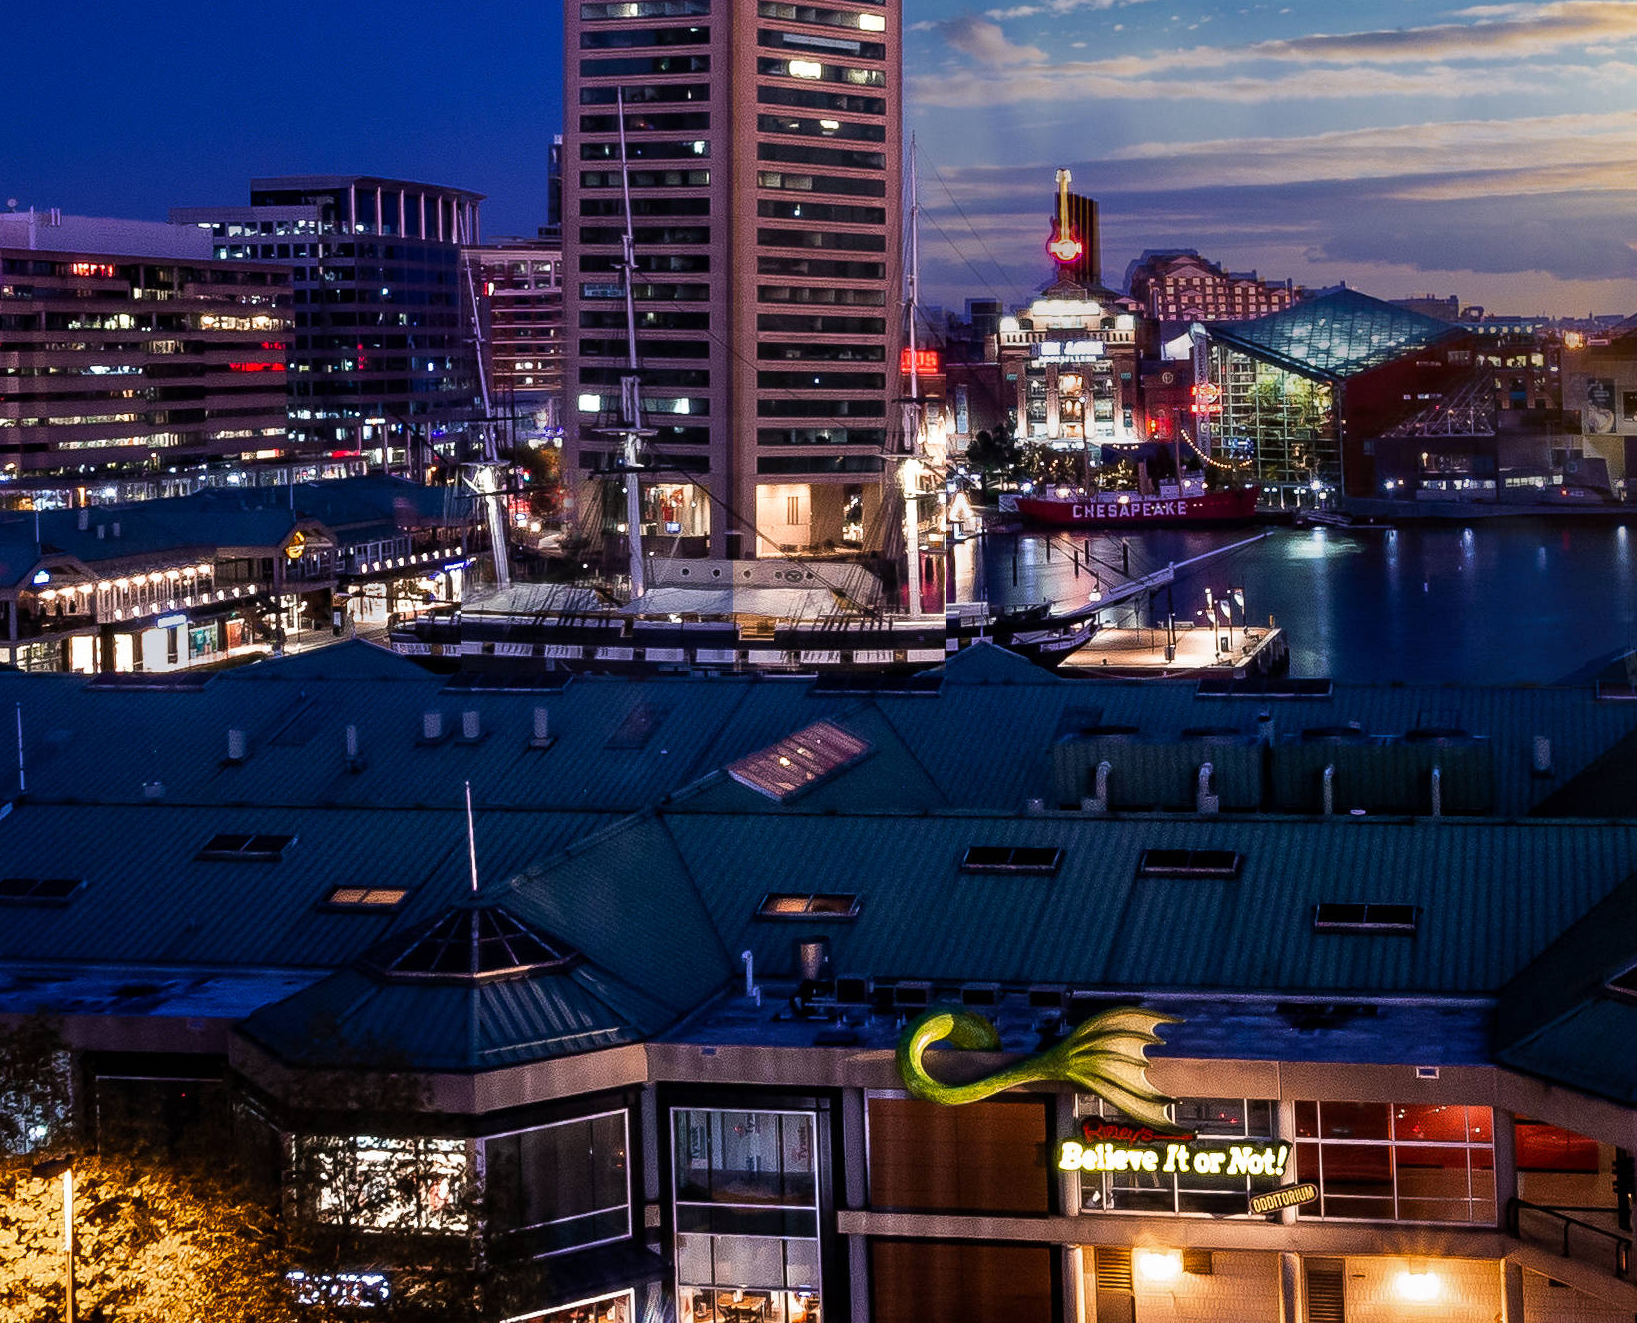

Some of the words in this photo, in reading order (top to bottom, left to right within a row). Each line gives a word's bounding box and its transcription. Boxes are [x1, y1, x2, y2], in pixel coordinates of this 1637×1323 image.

[1072, 501, 1187, 518] CHESAPEAKE
[1059, 1142, 1159, 1172] Believe
[1163, 1144, 1190, 1174] It
[1193, 1151, 1226, 1175] or
[1226, 1144, 1288, 1177] Not!
[1252, 1185, 1315, 1215] ODDITORIUM
